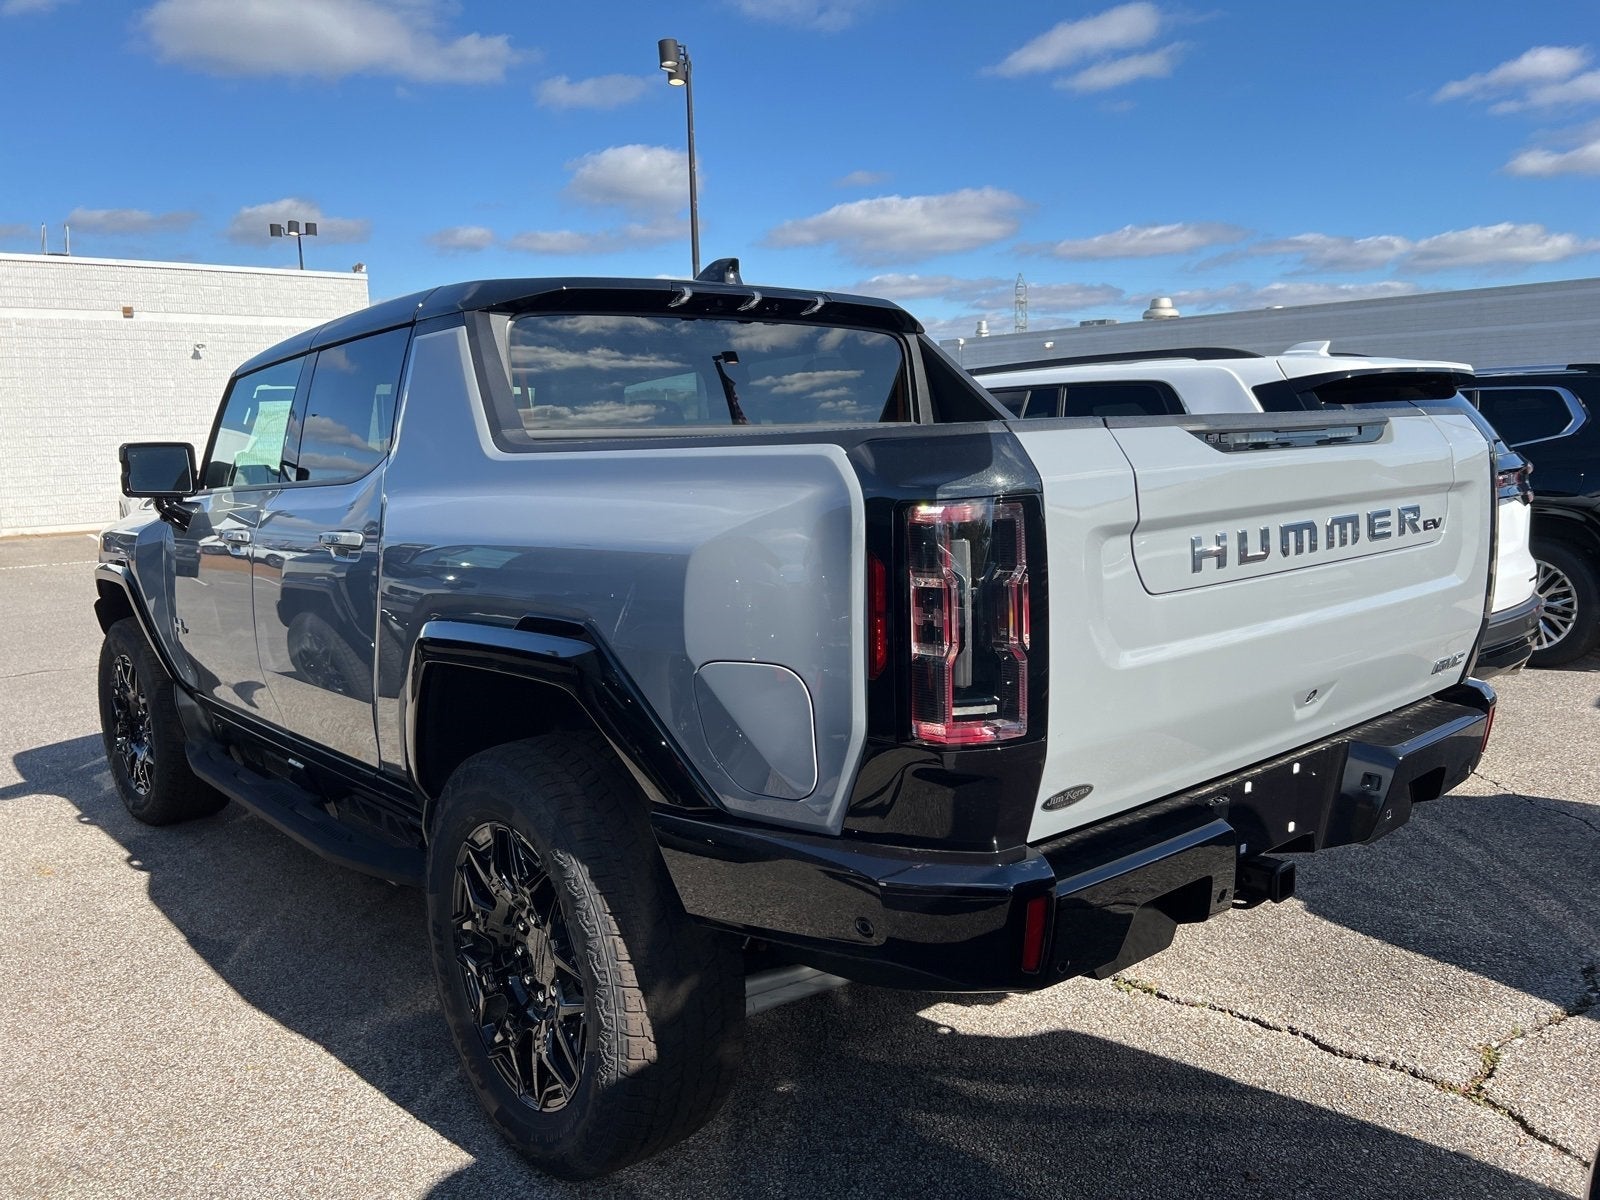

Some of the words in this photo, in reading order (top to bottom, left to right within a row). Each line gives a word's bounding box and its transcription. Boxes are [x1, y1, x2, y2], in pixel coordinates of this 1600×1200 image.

[1190, 504, 1421, 574] HUMMER
[1423, 517, 1442, 531] EV
[1047, 796, 1064, 806] Jim
